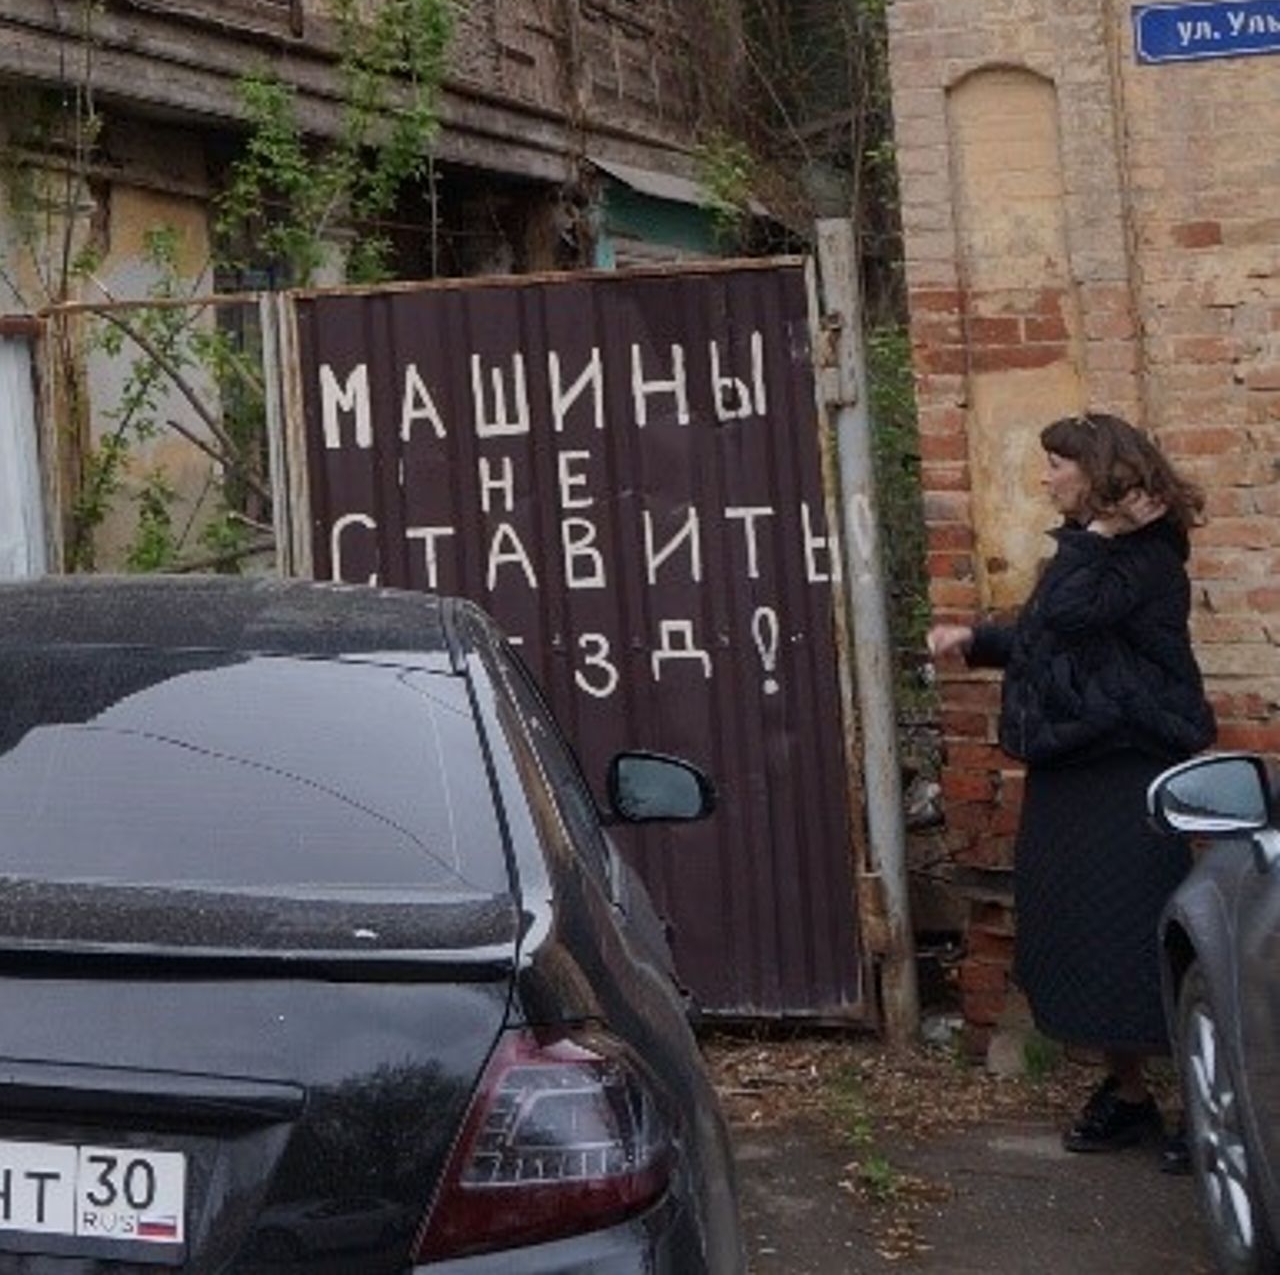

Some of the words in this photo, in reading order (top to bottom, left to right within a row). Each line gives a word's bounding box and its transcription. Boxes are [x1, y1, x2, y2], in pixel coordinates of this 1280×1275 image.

[1177, 20, 1222, 47] ул.
[318, 330, 767, 449] МАШИНЫ
[478, 450, 594, 513] НЕ
[330, 502, 840, 592] СТАВИТЬ
[85, 1154, 156, 1211] 30
[82, 1211, 136, 1234] RUS
